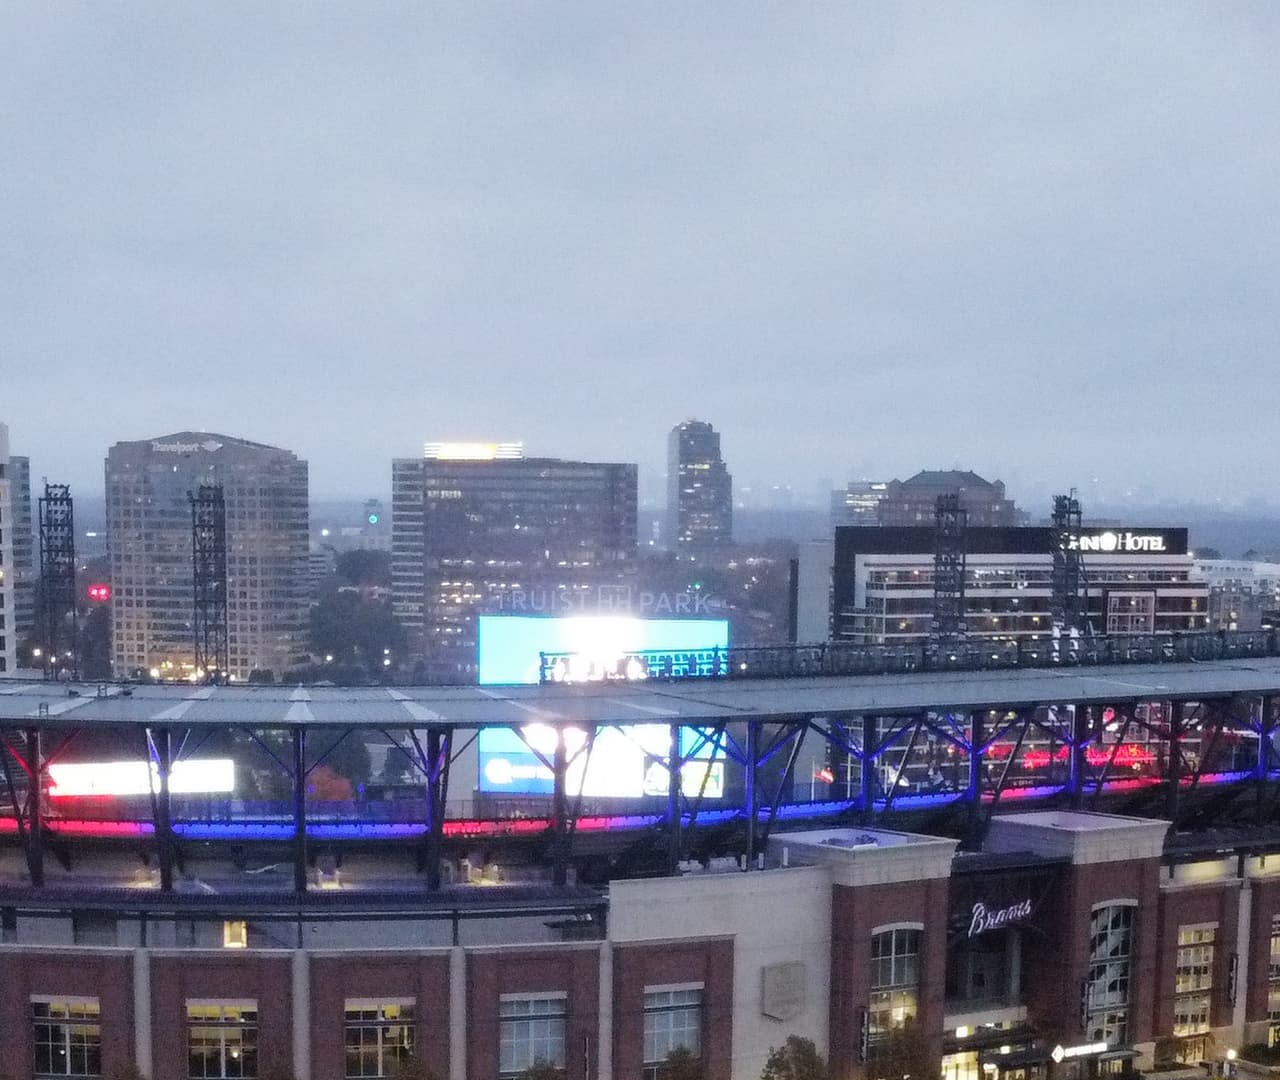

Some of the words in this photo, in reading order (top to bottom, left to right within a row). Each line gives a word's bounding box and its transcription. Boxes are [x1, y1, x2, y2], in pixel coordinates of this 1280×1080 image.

[1117, 532, 1166, 550] HOTEL
[497, 590, 591, 610] TRUIST
[639, 592, 712, 613] PARK
[968, 899, 1031, 938] Braves
